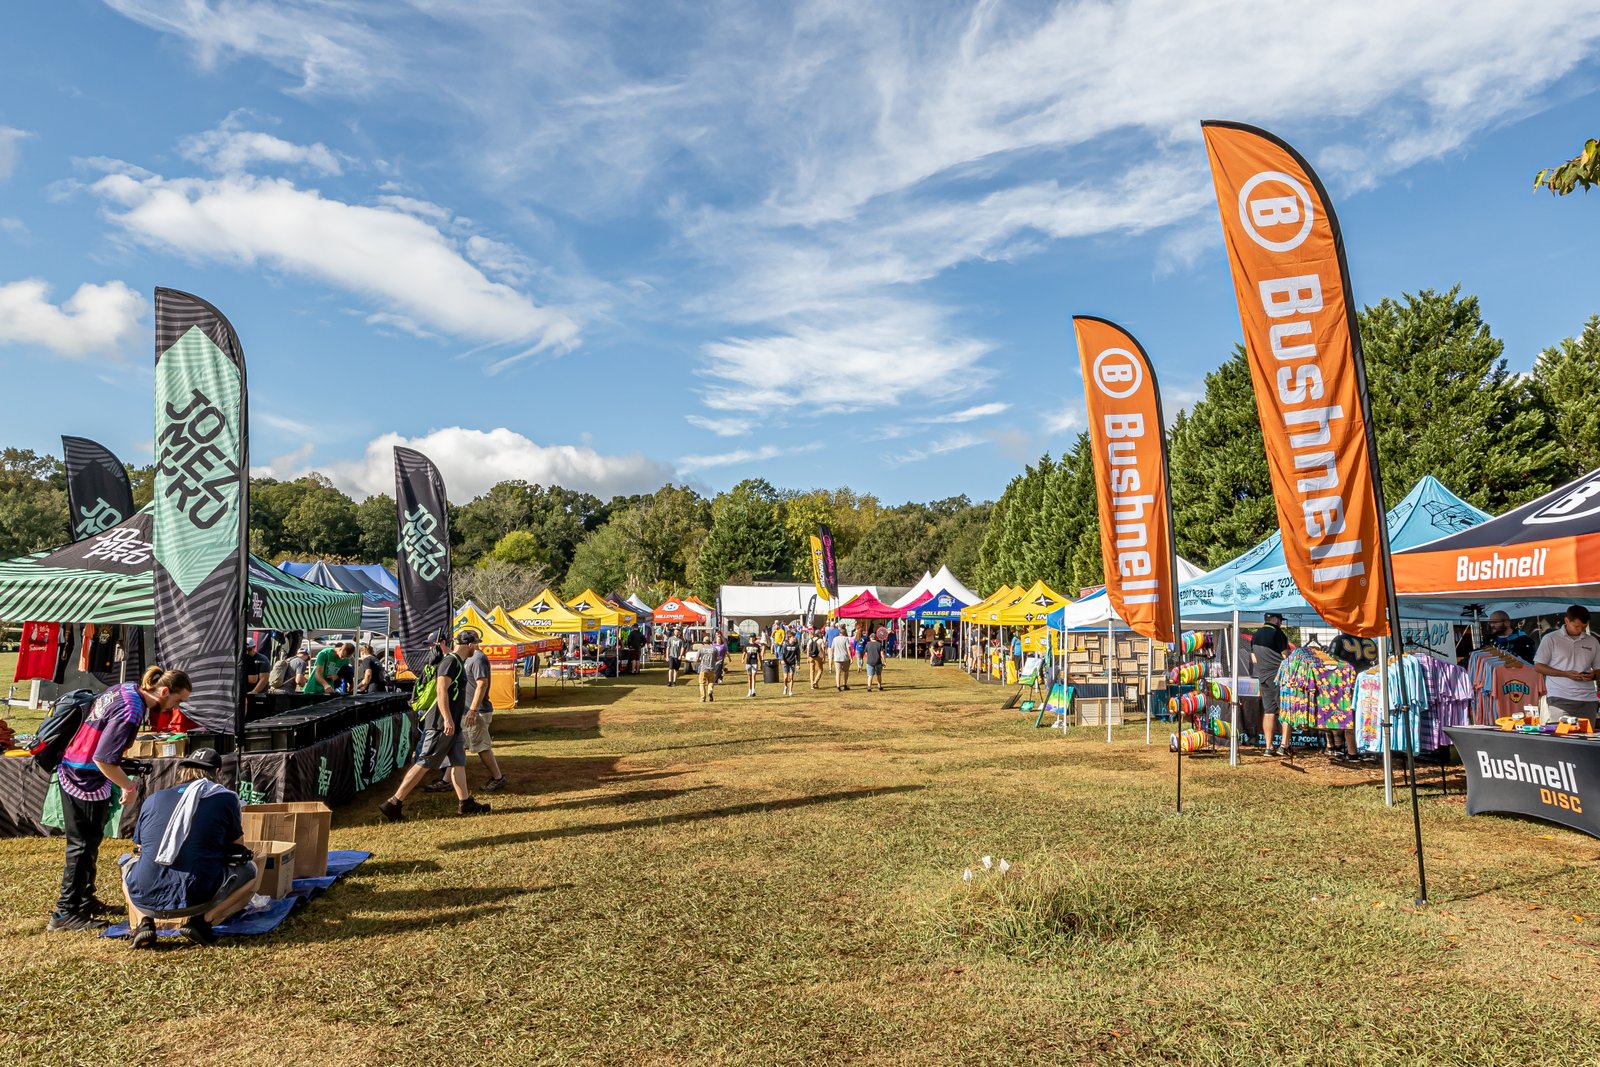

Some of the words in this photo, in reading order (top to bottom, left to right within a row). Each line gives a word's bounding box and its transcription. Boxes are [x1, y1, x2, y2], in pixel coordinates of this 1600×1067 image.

[1258, 272, 1367, 584] Bushnell
[1103, 412, 1159, 606] Bushnell
[1456, 547, 1549, 582] Bushnell
[1179, 589, 1192, 600] EDDY
[1260, 580, 1275, 592] THE
[1343, 639, 1377, 661] 42
[1476, 750, 1579, 794] Bushnell
[1539, 787, 1583, 814] DISC
